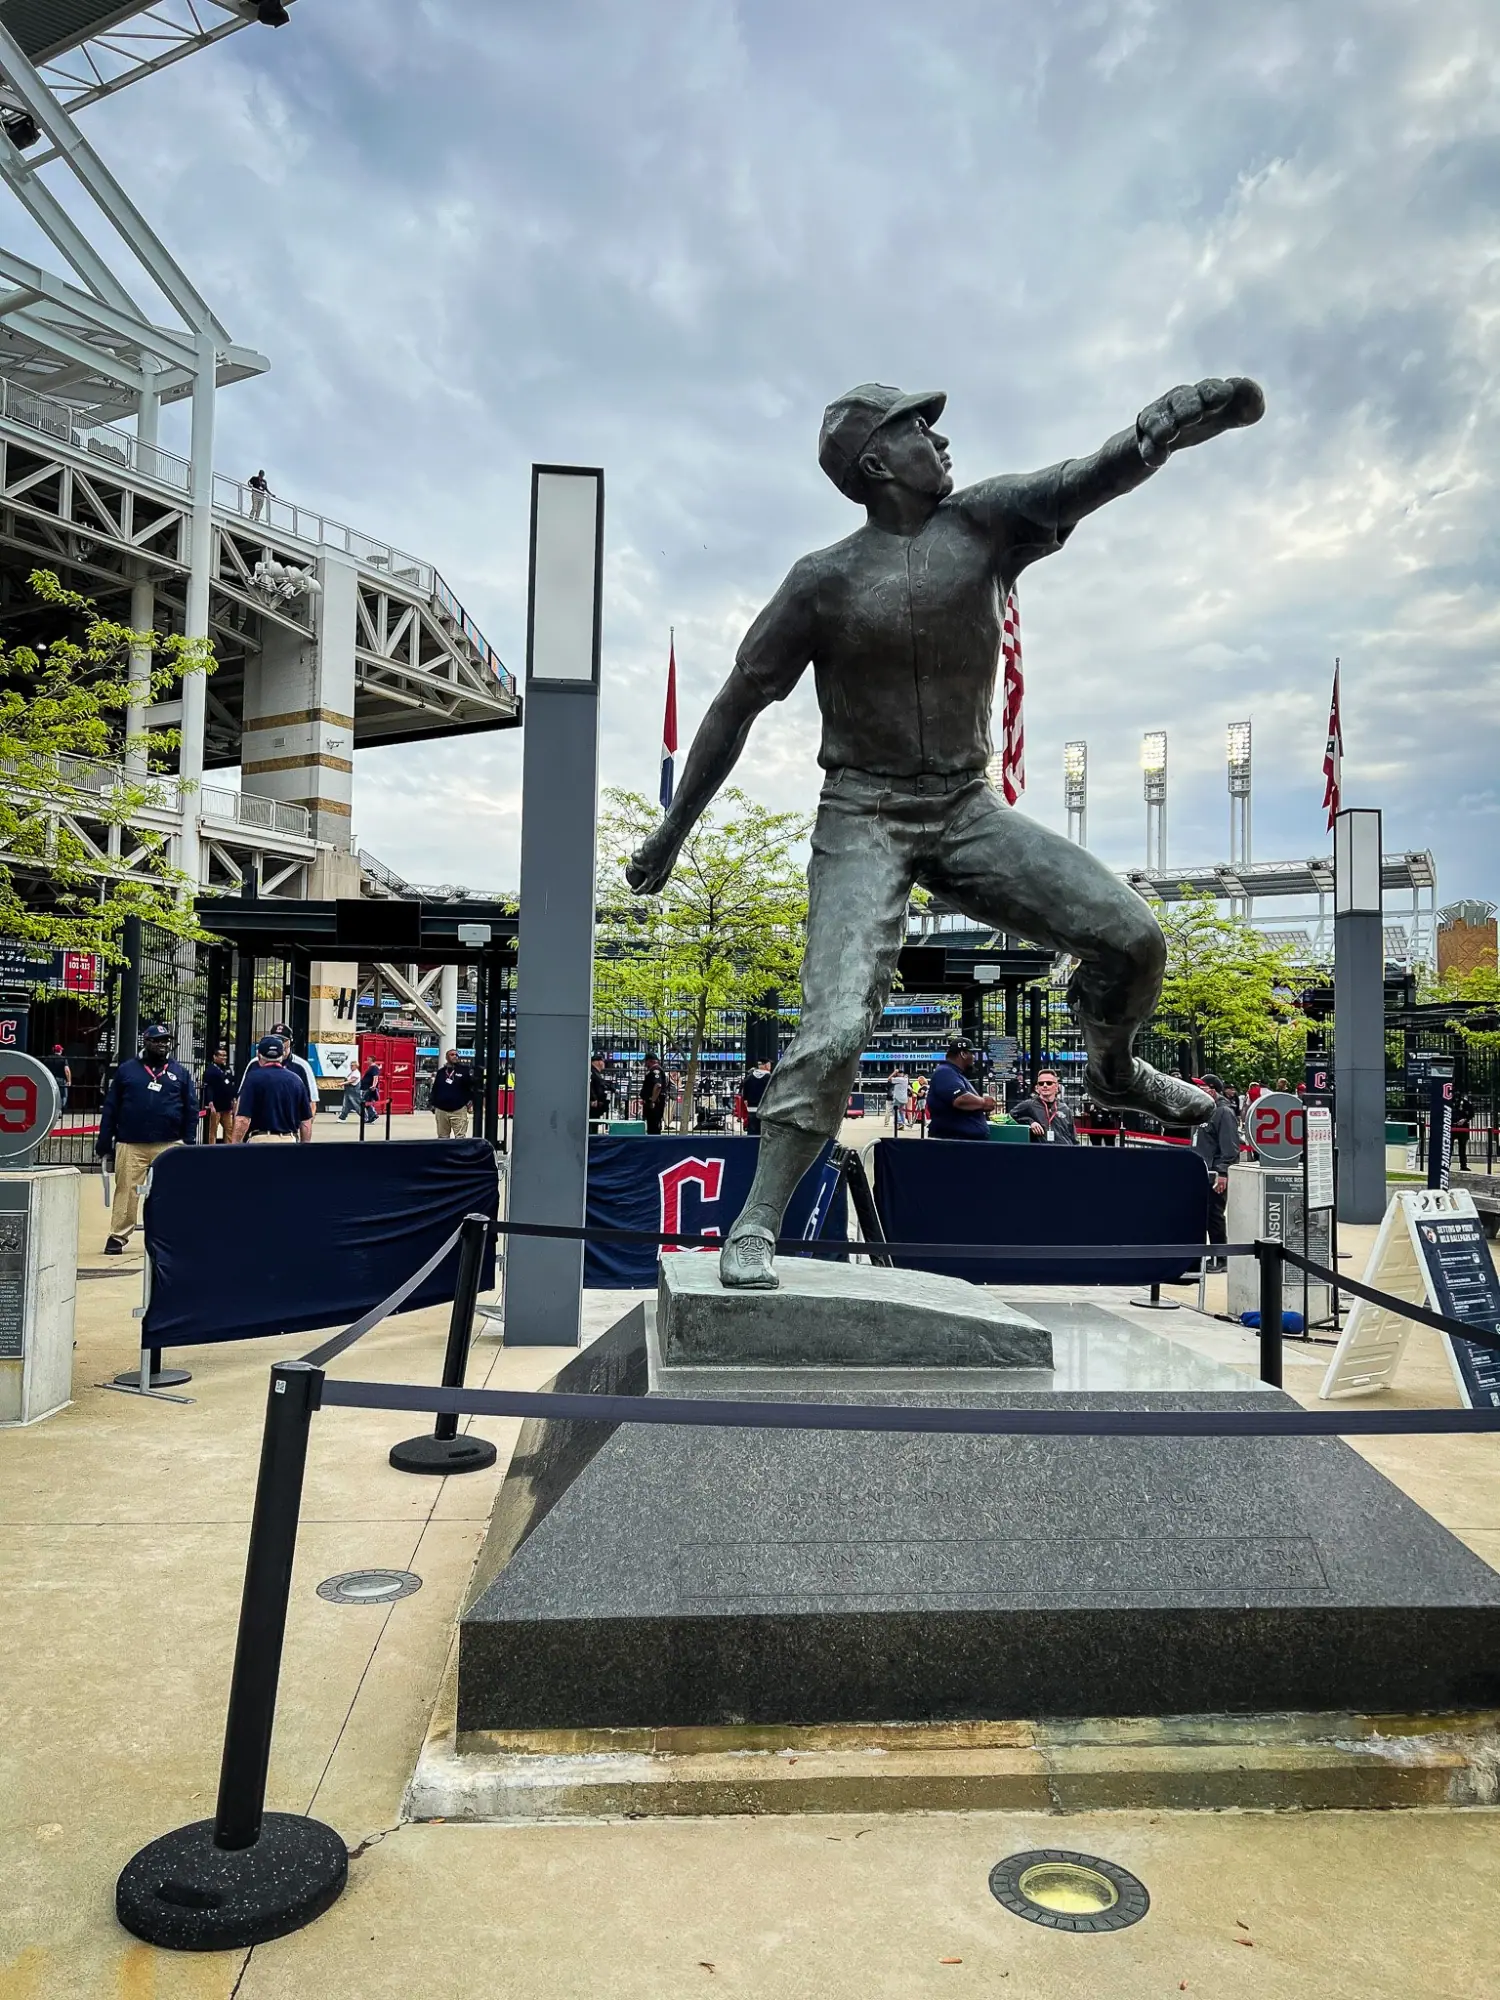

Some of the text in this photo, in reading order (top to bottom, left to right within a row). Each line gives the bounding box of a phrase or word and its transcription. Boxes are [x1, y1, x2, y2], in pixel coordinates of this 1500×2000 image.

[1314, 1072, 1327, 1089] C
[1442, 1083, 1453, 1100] C
[0, 1074, 38, 1134] 9
[1255, 1106, 1304, 1146] 20
[1439, 1104, 1453, 1193] PROGRESSIVE FIEL
[1268, 1201, 1281, 1239] NSON
